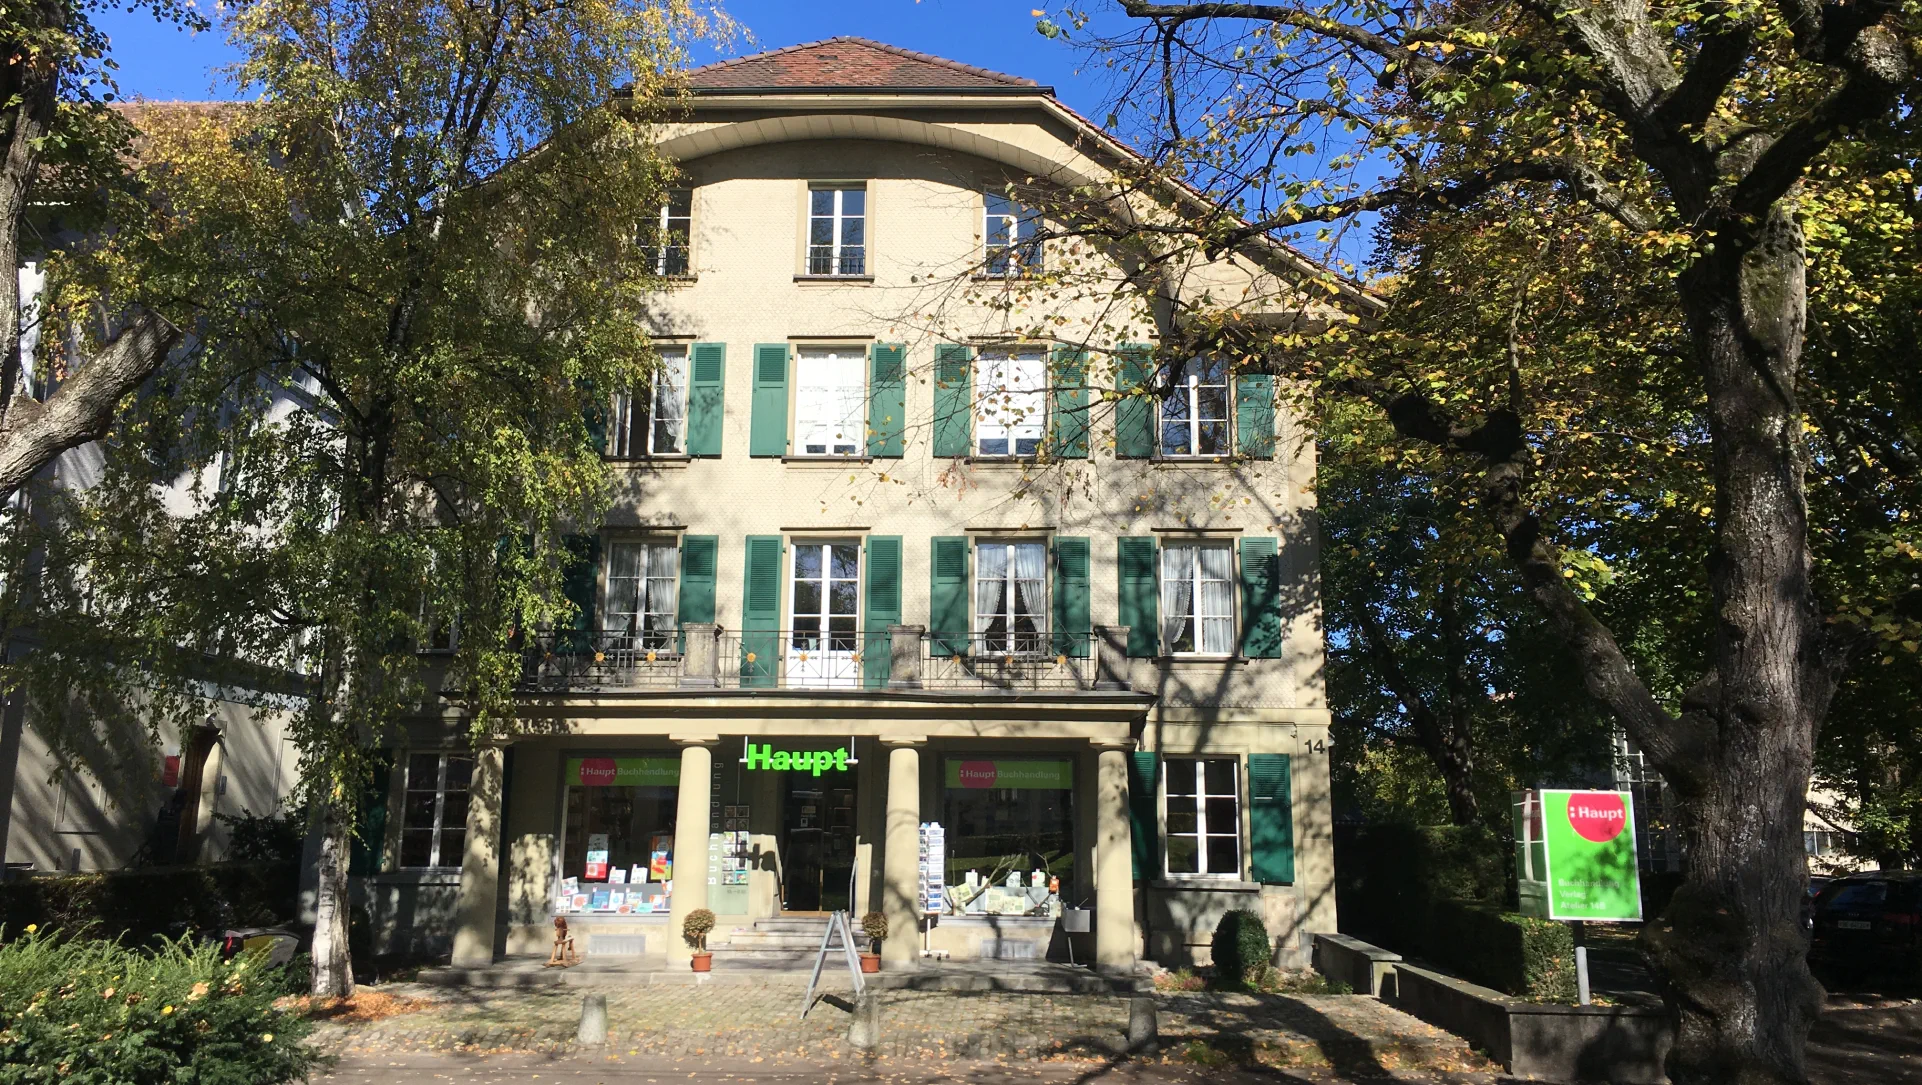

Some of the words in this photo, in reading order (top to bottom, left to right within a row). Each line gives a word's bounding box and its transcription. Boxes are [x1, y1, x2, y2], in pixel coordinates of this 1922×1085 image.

[1304, 739, 1326, 754] 14
[747, 743, 848, 777] Haupt
[617, 768, 680, 778] Buchhandlung
[997, 770, 1060, 781] Buchhandlung
[707, 761, 724, 885] Buchhandlung
[1558, 878, 1620, 888] Buchhandung
[1559, 890, 1586, 899] Verlag
[1560, 901, 1588, 910] Atelier
